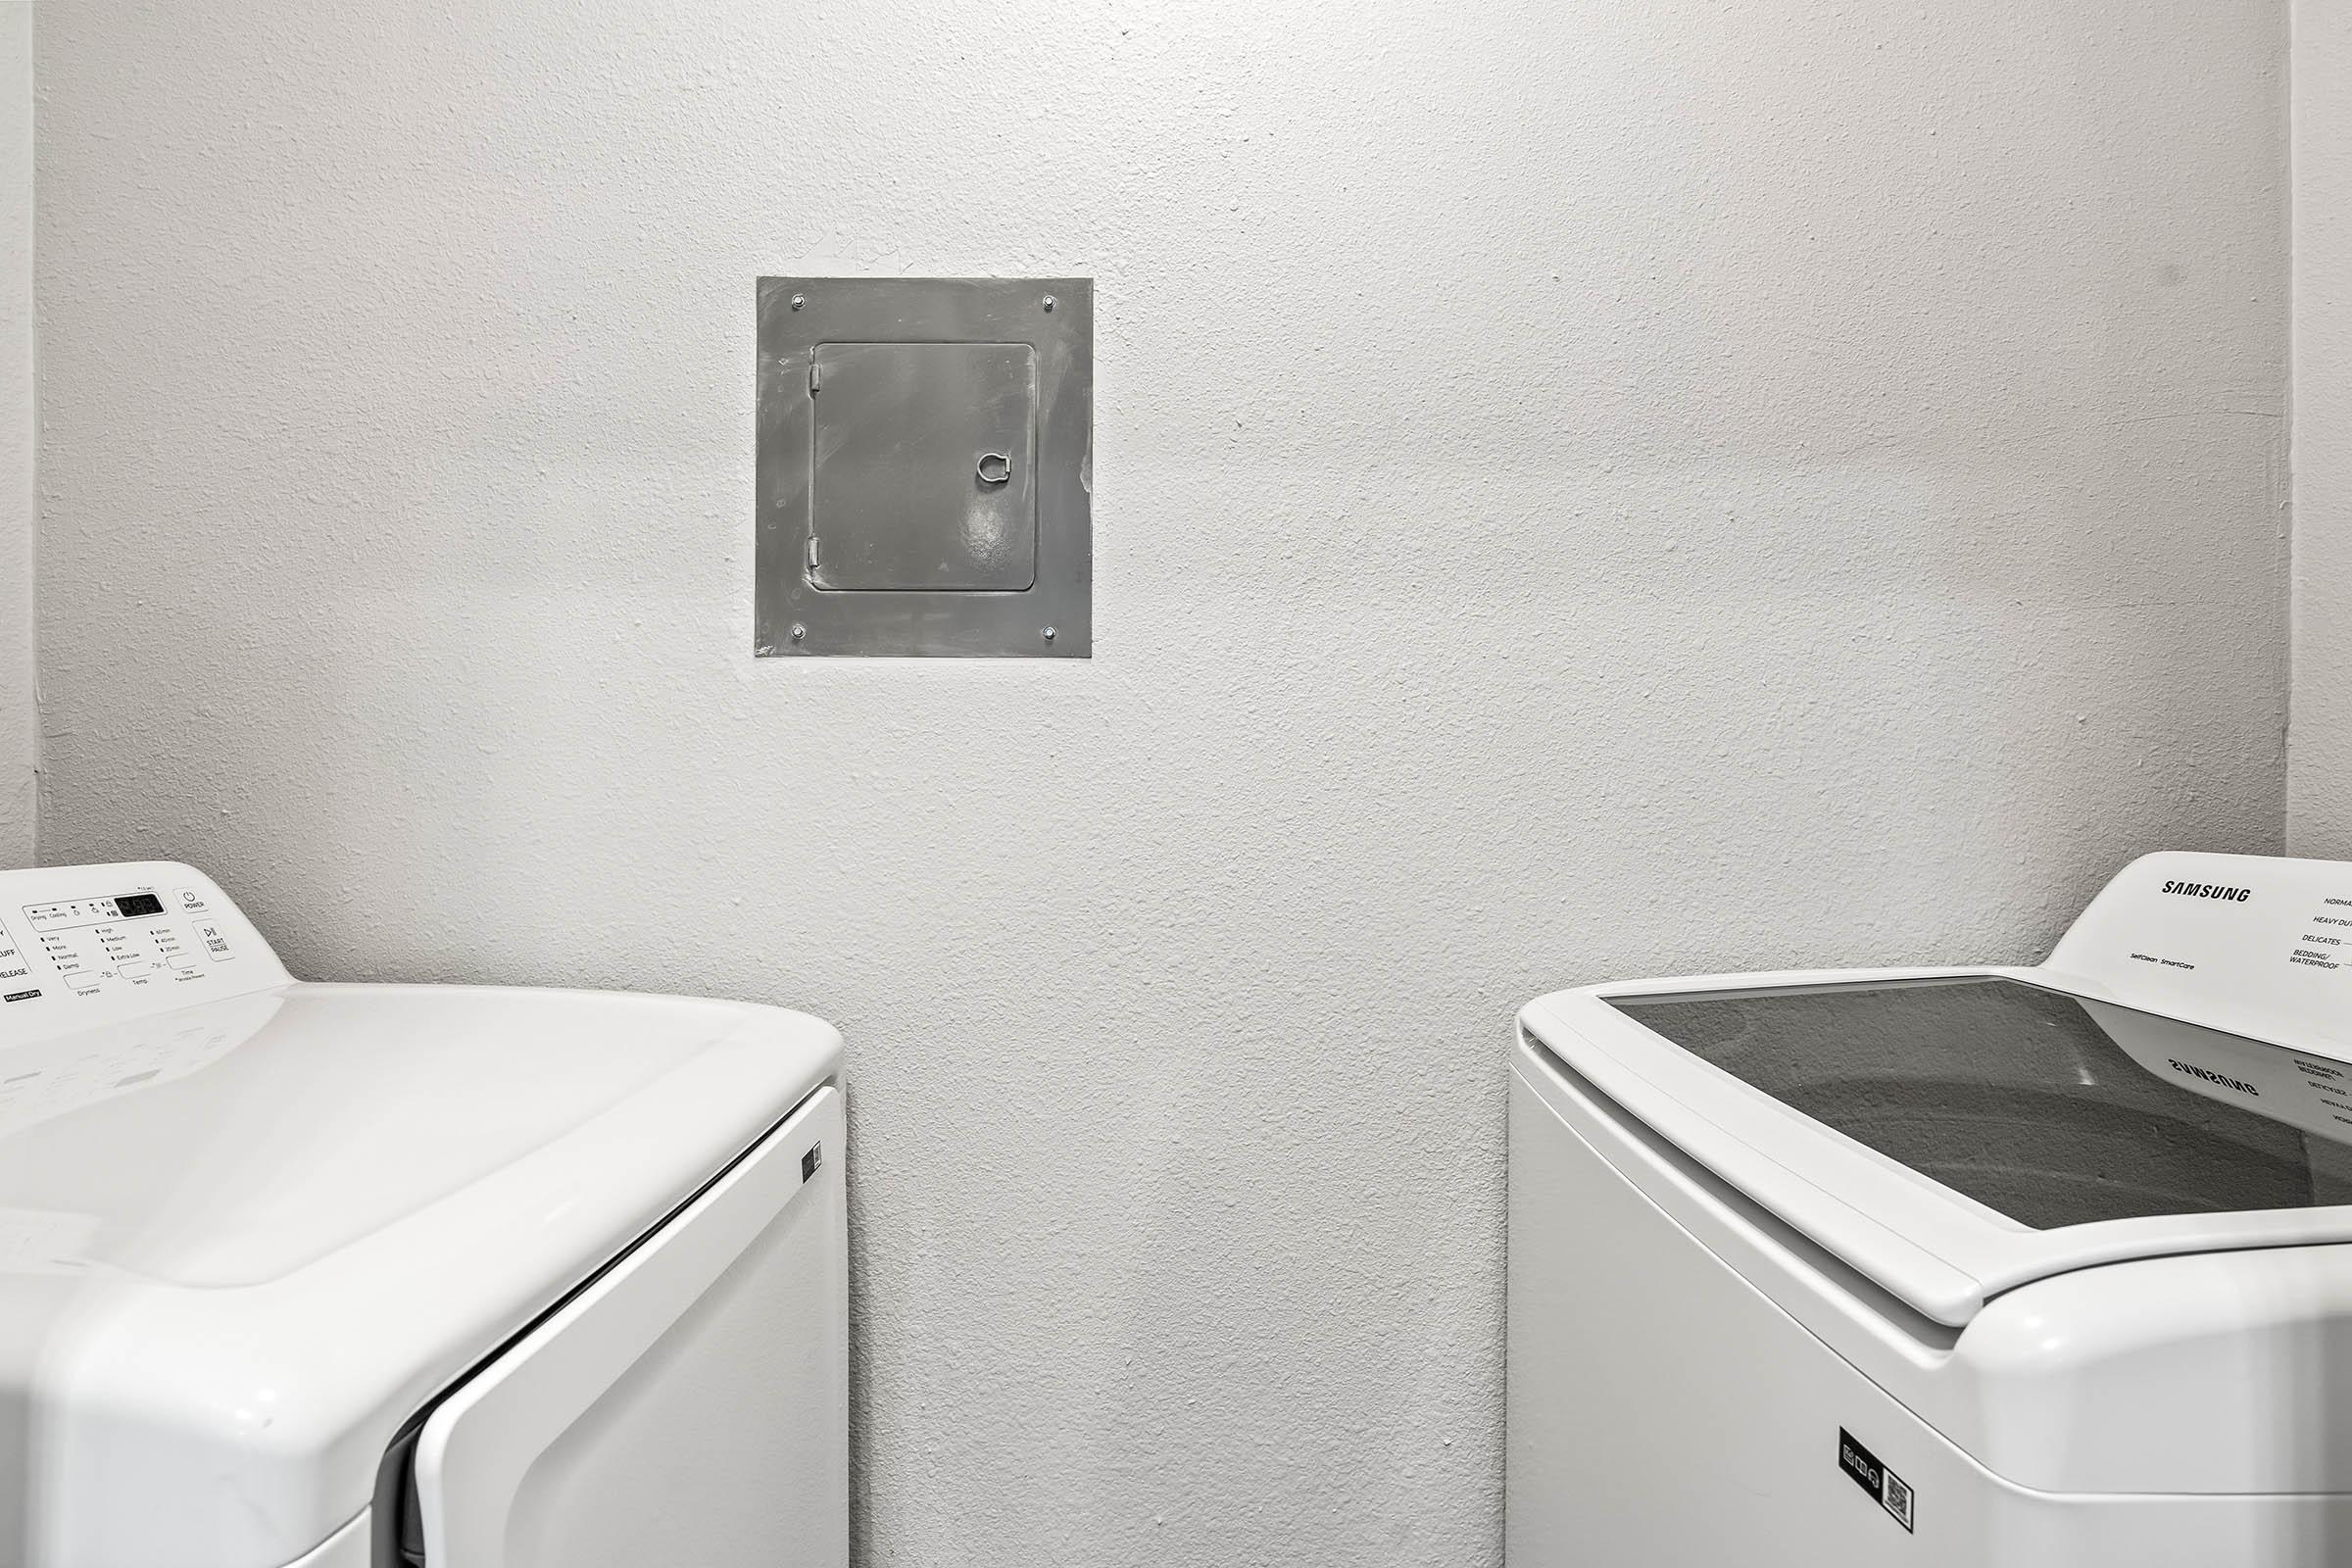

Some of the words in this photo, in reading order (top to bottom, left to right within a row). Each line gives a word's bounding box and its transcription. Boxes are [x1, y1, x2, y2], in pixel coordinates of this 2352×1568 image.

[2162, 880, 2251, 903] SAMSUNG
[184, 901, 205, 909] POWER
[2324, 898, 2352, 907] NORMA
[2313, 916, 2338, 925] HEAVY
[207, 938, 225, 947] START
[2302, 934, 2341, 947] DELICATES
[211, 945, 230, 954] PAUSE
[2293, 949, 2331, 961] BEDDING/
[2131, 953, 2158, 963] SelfClean
[2160, 958, 2195, 970] SmartCare
[2289, 956, 2340, 970] WATERPROOF
[5, 992, 29, 1001] Manual
[77, 988, 100, 997] Dryness
